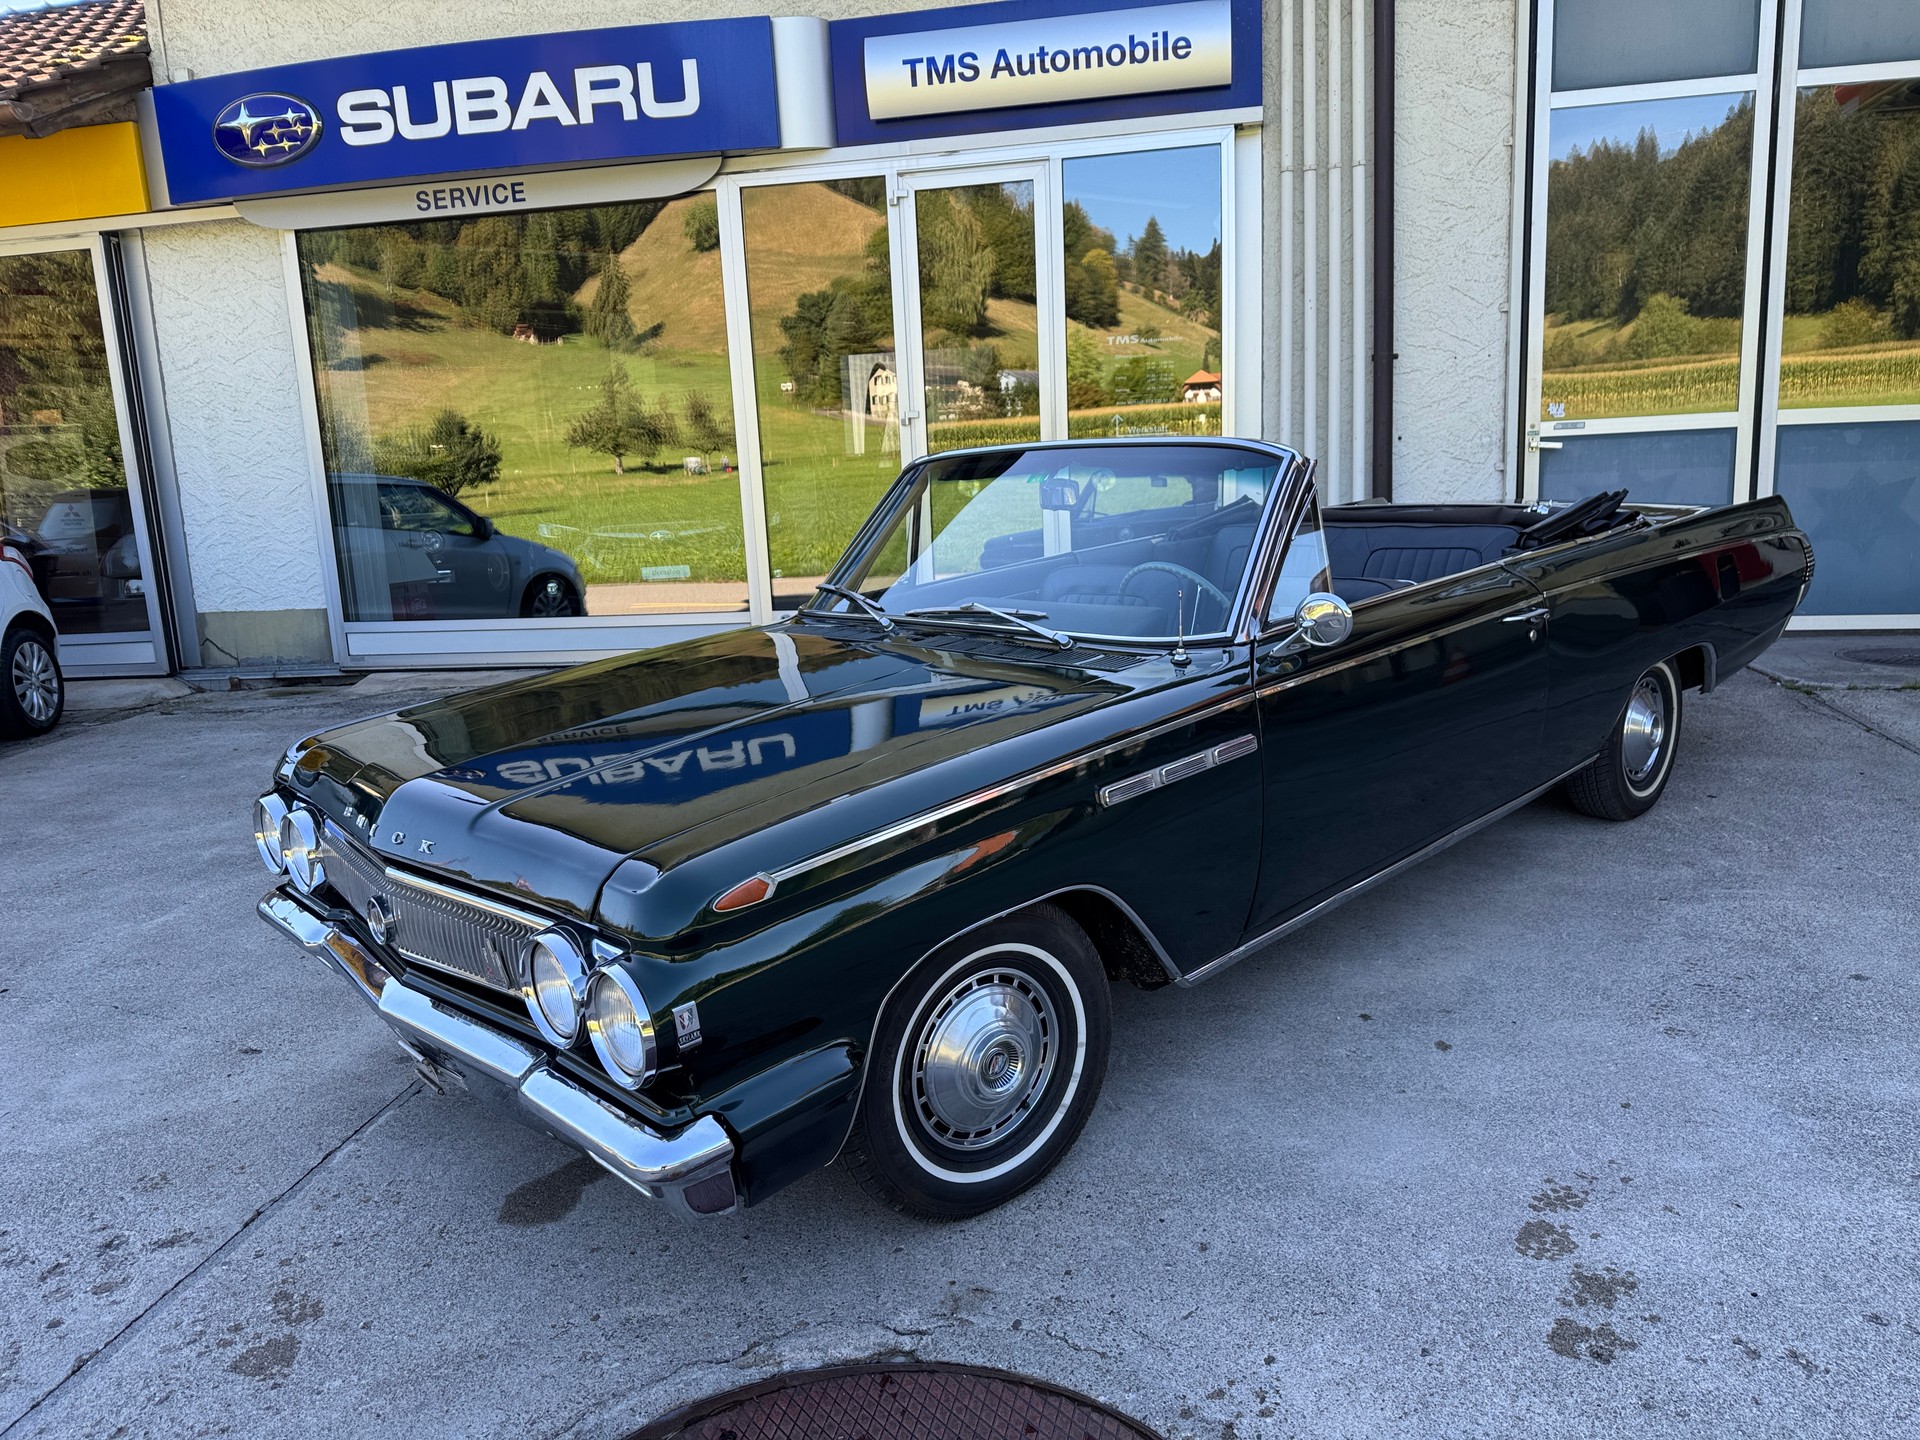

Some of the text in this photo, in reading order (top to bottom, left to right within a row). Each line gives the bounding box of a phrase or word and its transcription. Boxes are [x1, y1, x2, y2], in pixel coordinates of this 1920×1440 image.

[902, 30, 1192, 88] TMS Automobile
[336, 58, 700, 147] SUBARU
[416, 182, 526, 212] SERVICE
[1107, 335, 1140, 345] TMS
[1128, 425, 1168, 434] Werkstatt
